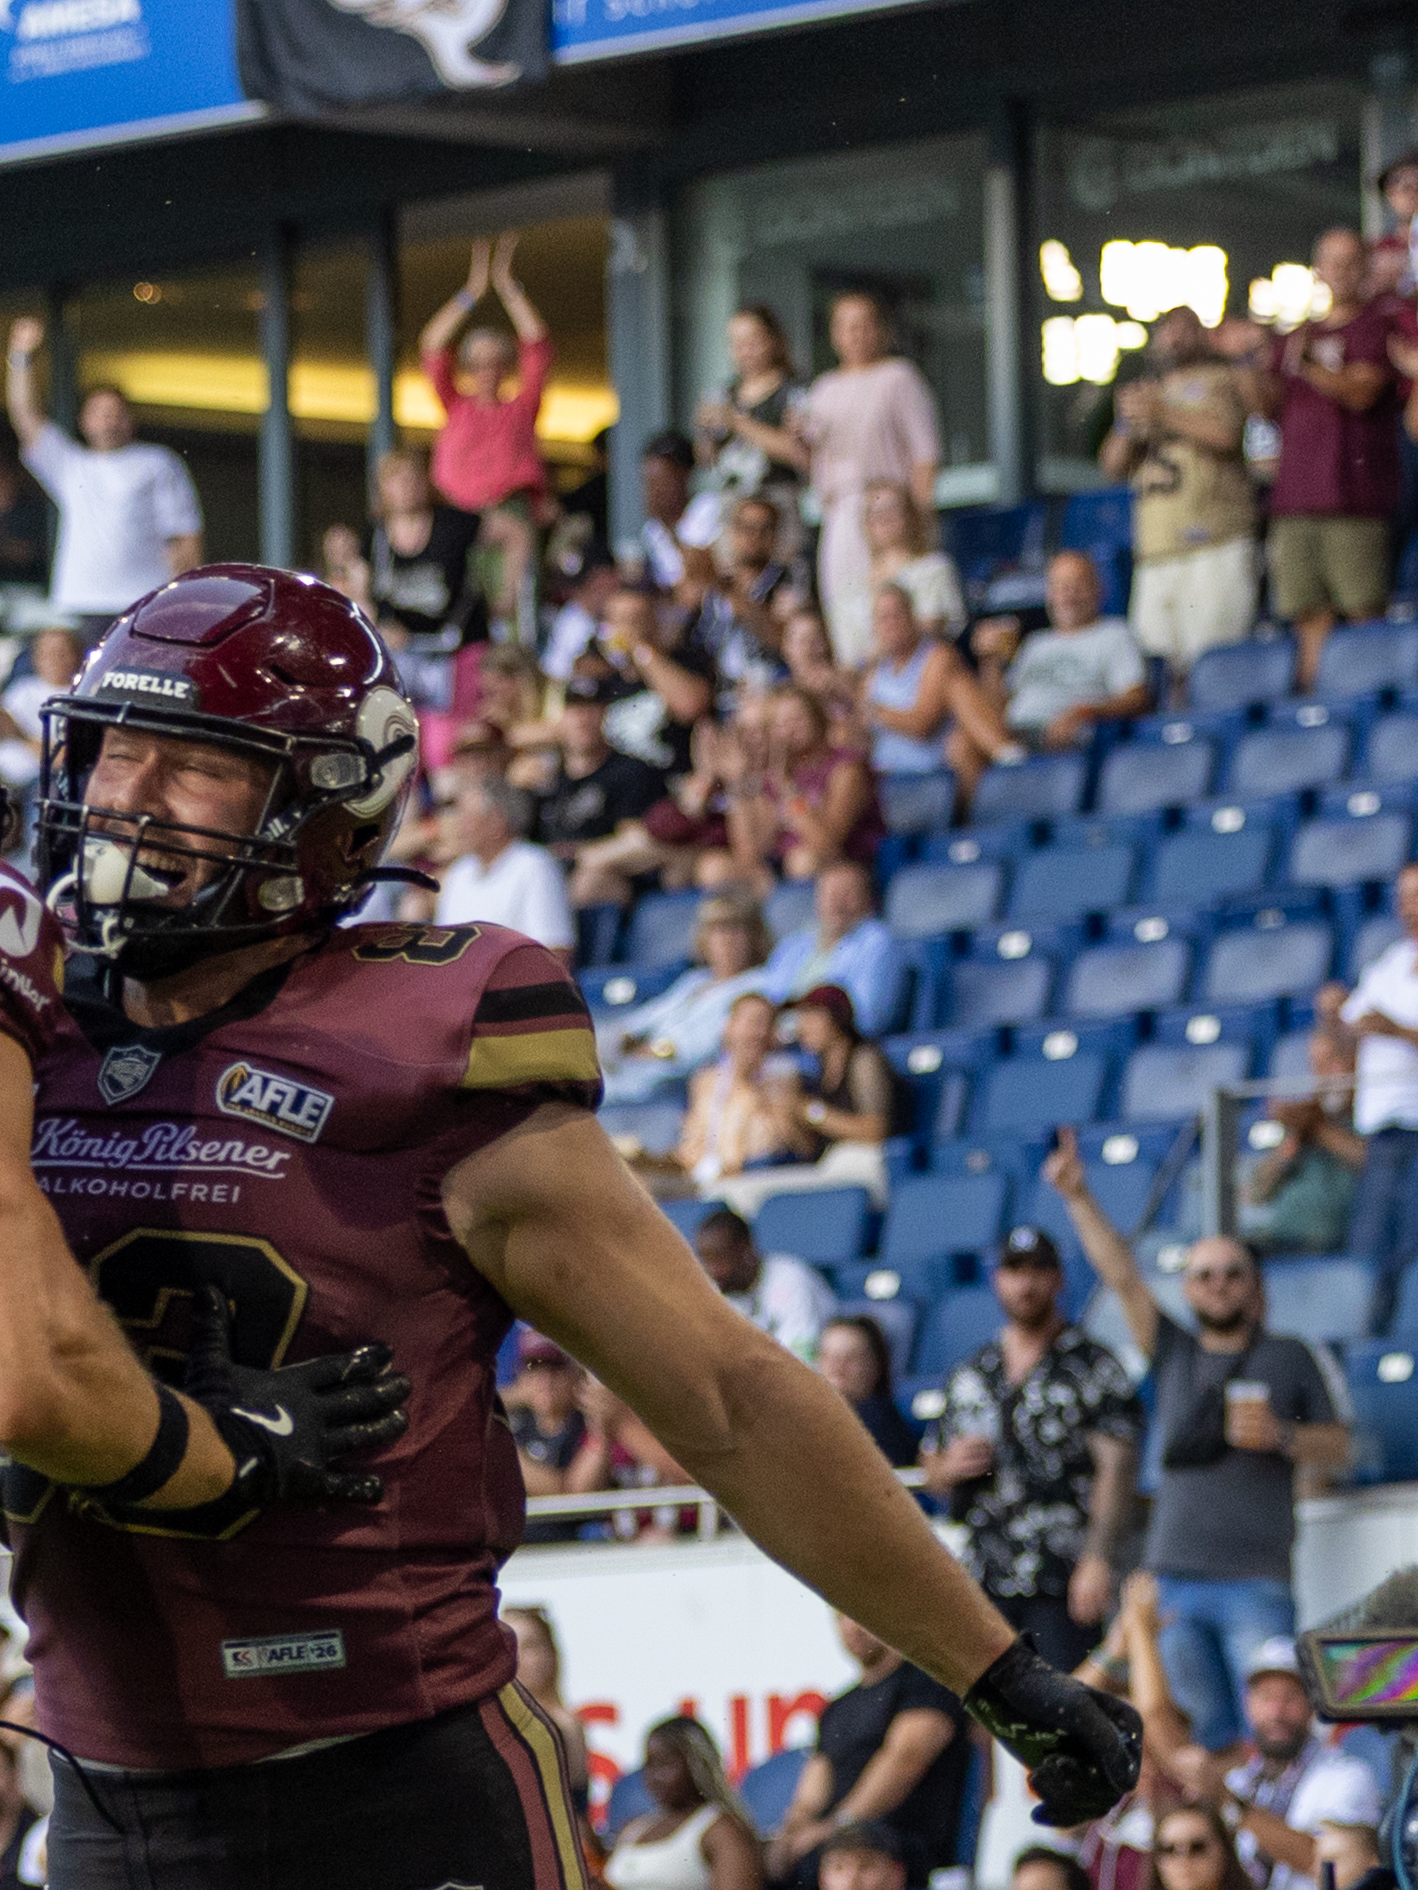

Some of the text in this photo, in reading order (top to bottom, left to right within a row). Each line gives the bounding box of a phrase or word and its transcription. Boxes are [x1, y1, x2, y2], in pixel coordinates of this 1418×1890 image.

[102, 671, 190, 698] FORELLE
[228, 1073, 325, 1130] AFLE
[31, 1117, 291, 1171] König Pilsener
[38, 1176, 241, 1204] ALKOHOLFREI
[268, 1644, 306, 1662] AFLE
